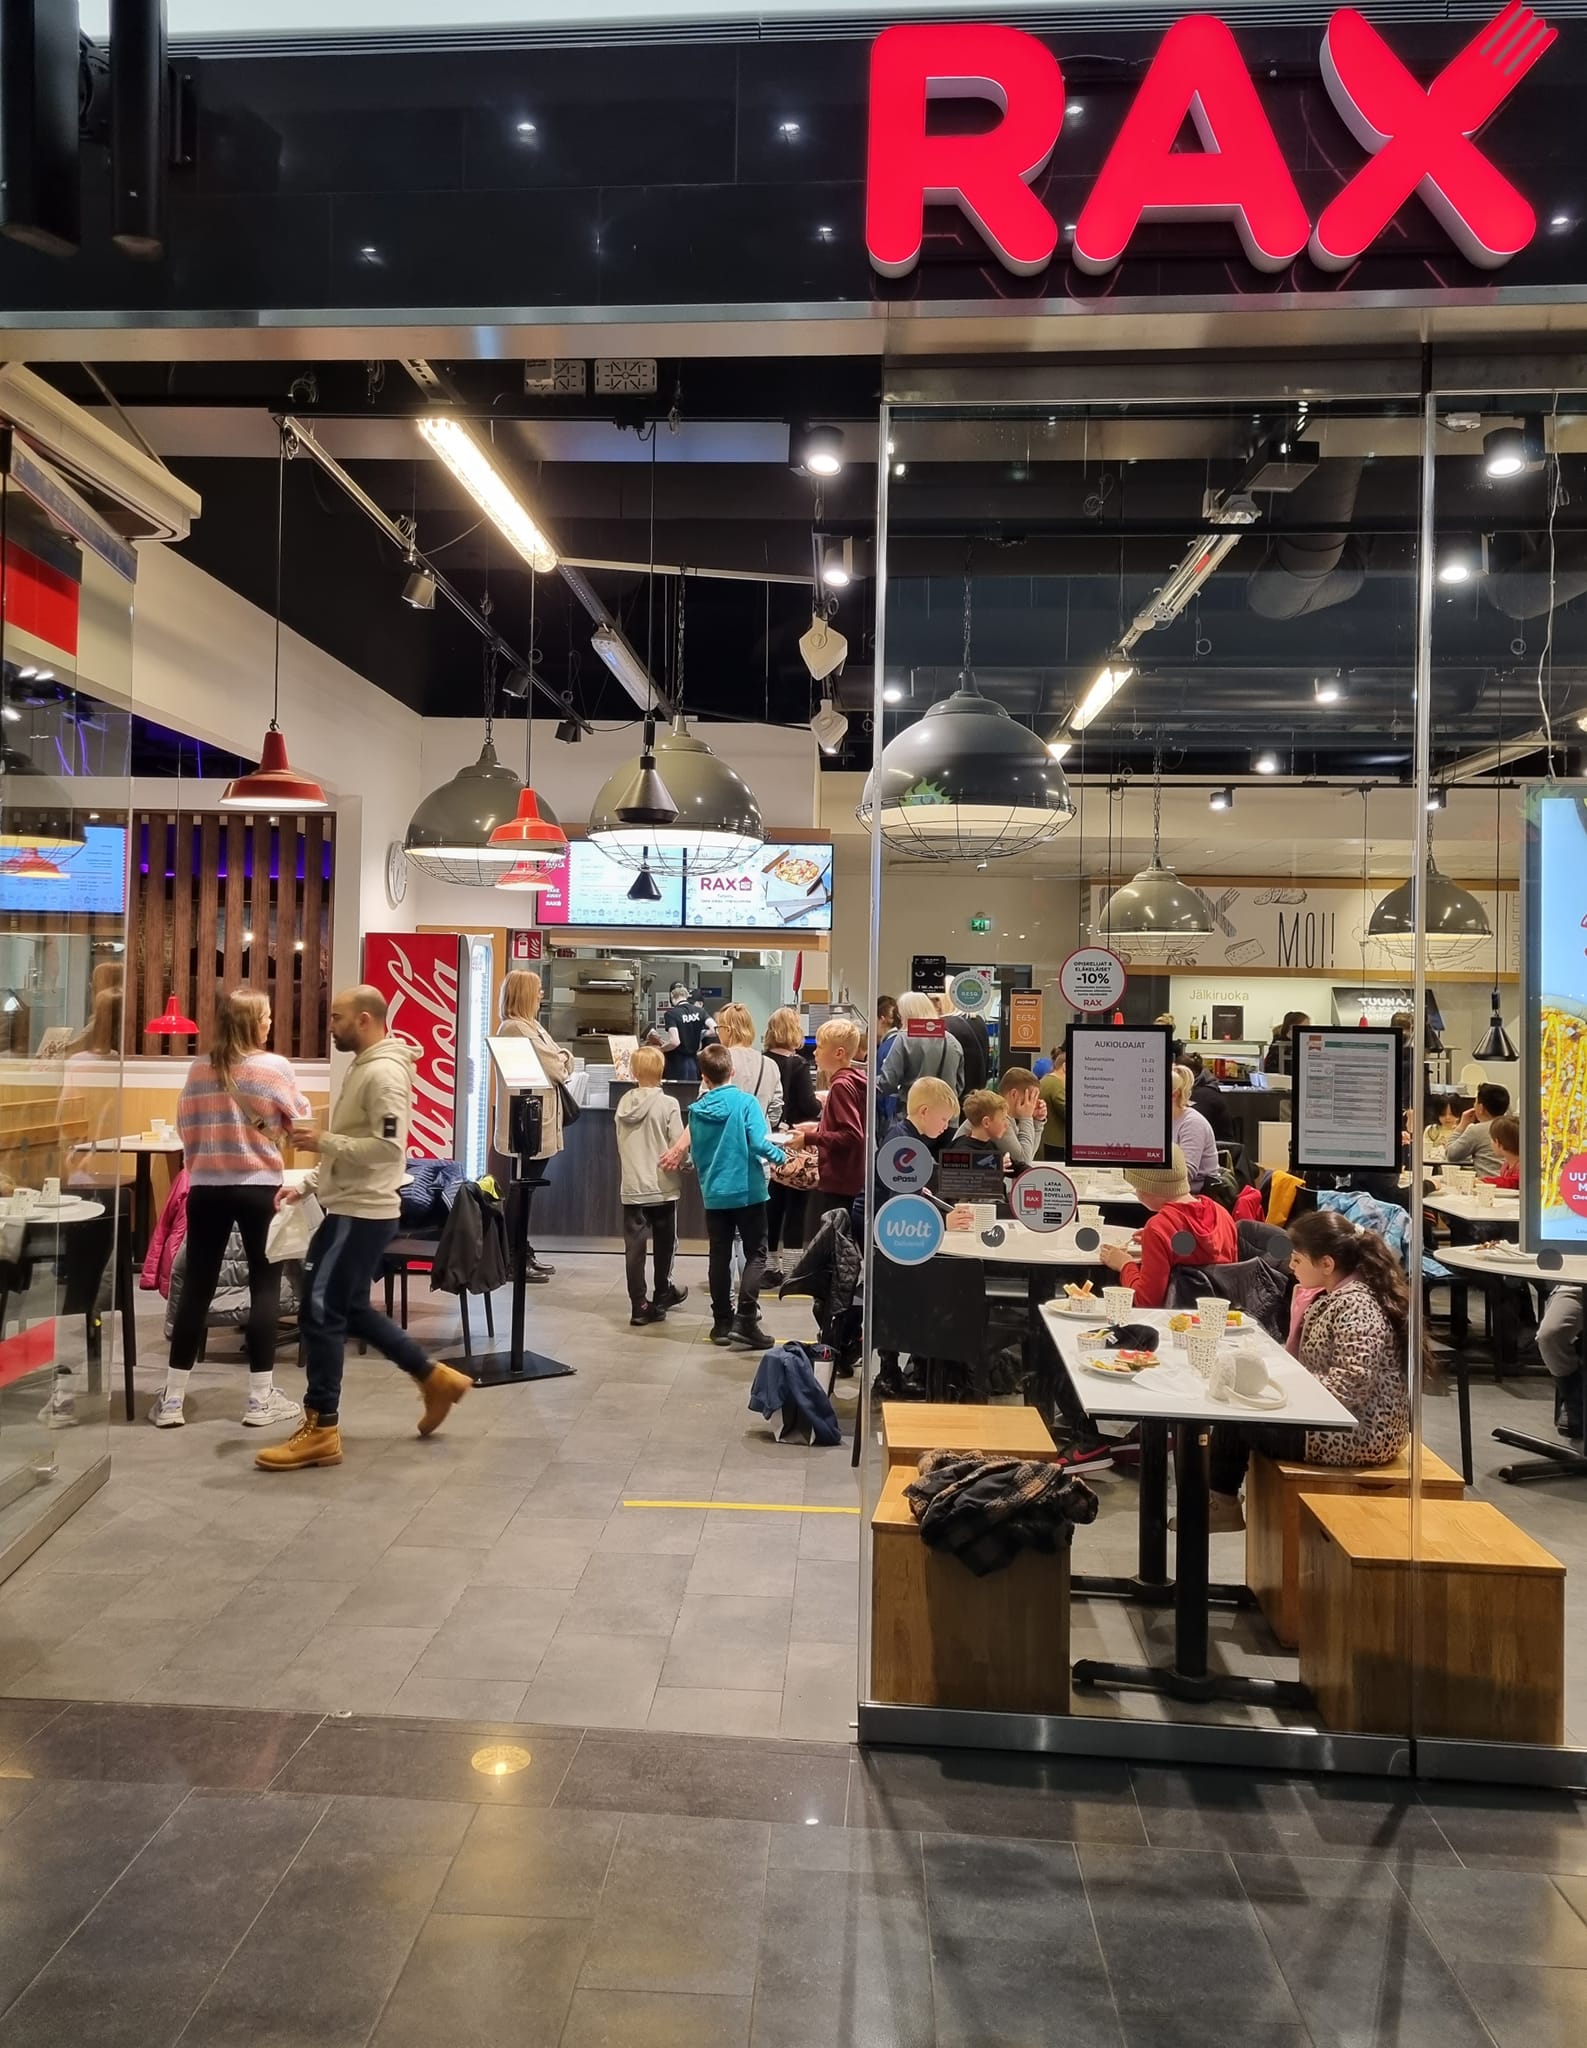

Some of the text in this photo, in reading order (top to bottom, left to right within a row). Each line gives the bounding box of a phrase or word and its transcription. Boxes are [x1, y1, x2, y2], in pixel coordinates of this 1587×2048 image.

[867, 1, 1558, 277] RAX
[700, 877, 737, 891] RAX
[1278, 911, 1335, 969] MOI!
[1076, 972, 1110, 985] -10%
[1189, 989, 1250, 1001] Jälkiruoka
[1083, 999, 1103, 1007] RAX
[682, 1012, 700, 1023] RAX
[1094, 1040, 1146, 1049] AUKIOLOAJAT
[1569, 1172, 1587, 1182] UU
[886, 1219, 933, 1238] Wolt
